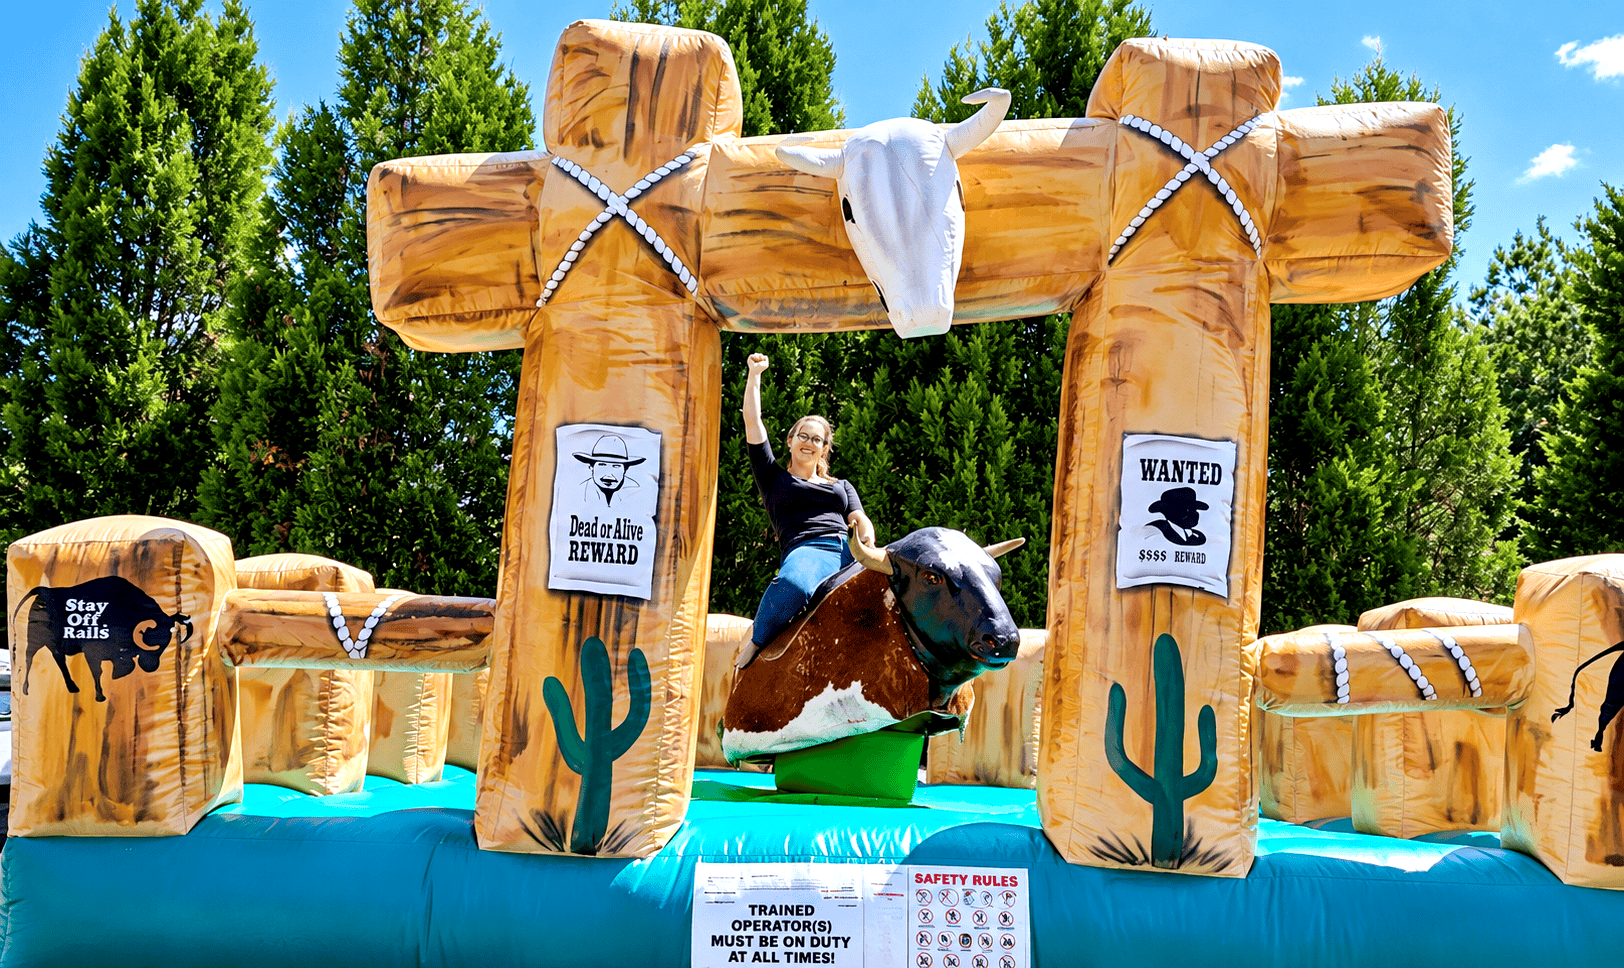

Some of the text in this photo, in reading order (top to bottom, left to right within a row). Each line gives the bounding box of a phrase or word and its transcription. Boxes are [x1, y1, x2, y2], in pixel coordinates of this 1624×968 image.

[1139, 458, 1222, 486] WANTED
[569, 514, 643, 541] Dead or Alive
[568, 540, 639, 565] REWARD
[1138, 549, 1206, 564] $$$$ REWARD
[65, 598, 109, 614] Stay
[67, 613, 102, 627] Off
[63, 625, 110, 639] Rails
[914, 873, 1018, 887] SAFETY RULES
[748, 904, 815, 916] TRAINED
[731, 919, 832, 934] OPERATOR(S)
[711, 935, 851, 948] MUST BE ON DUTY
[728, 951, 835, 964] AT ALL TIMES!
